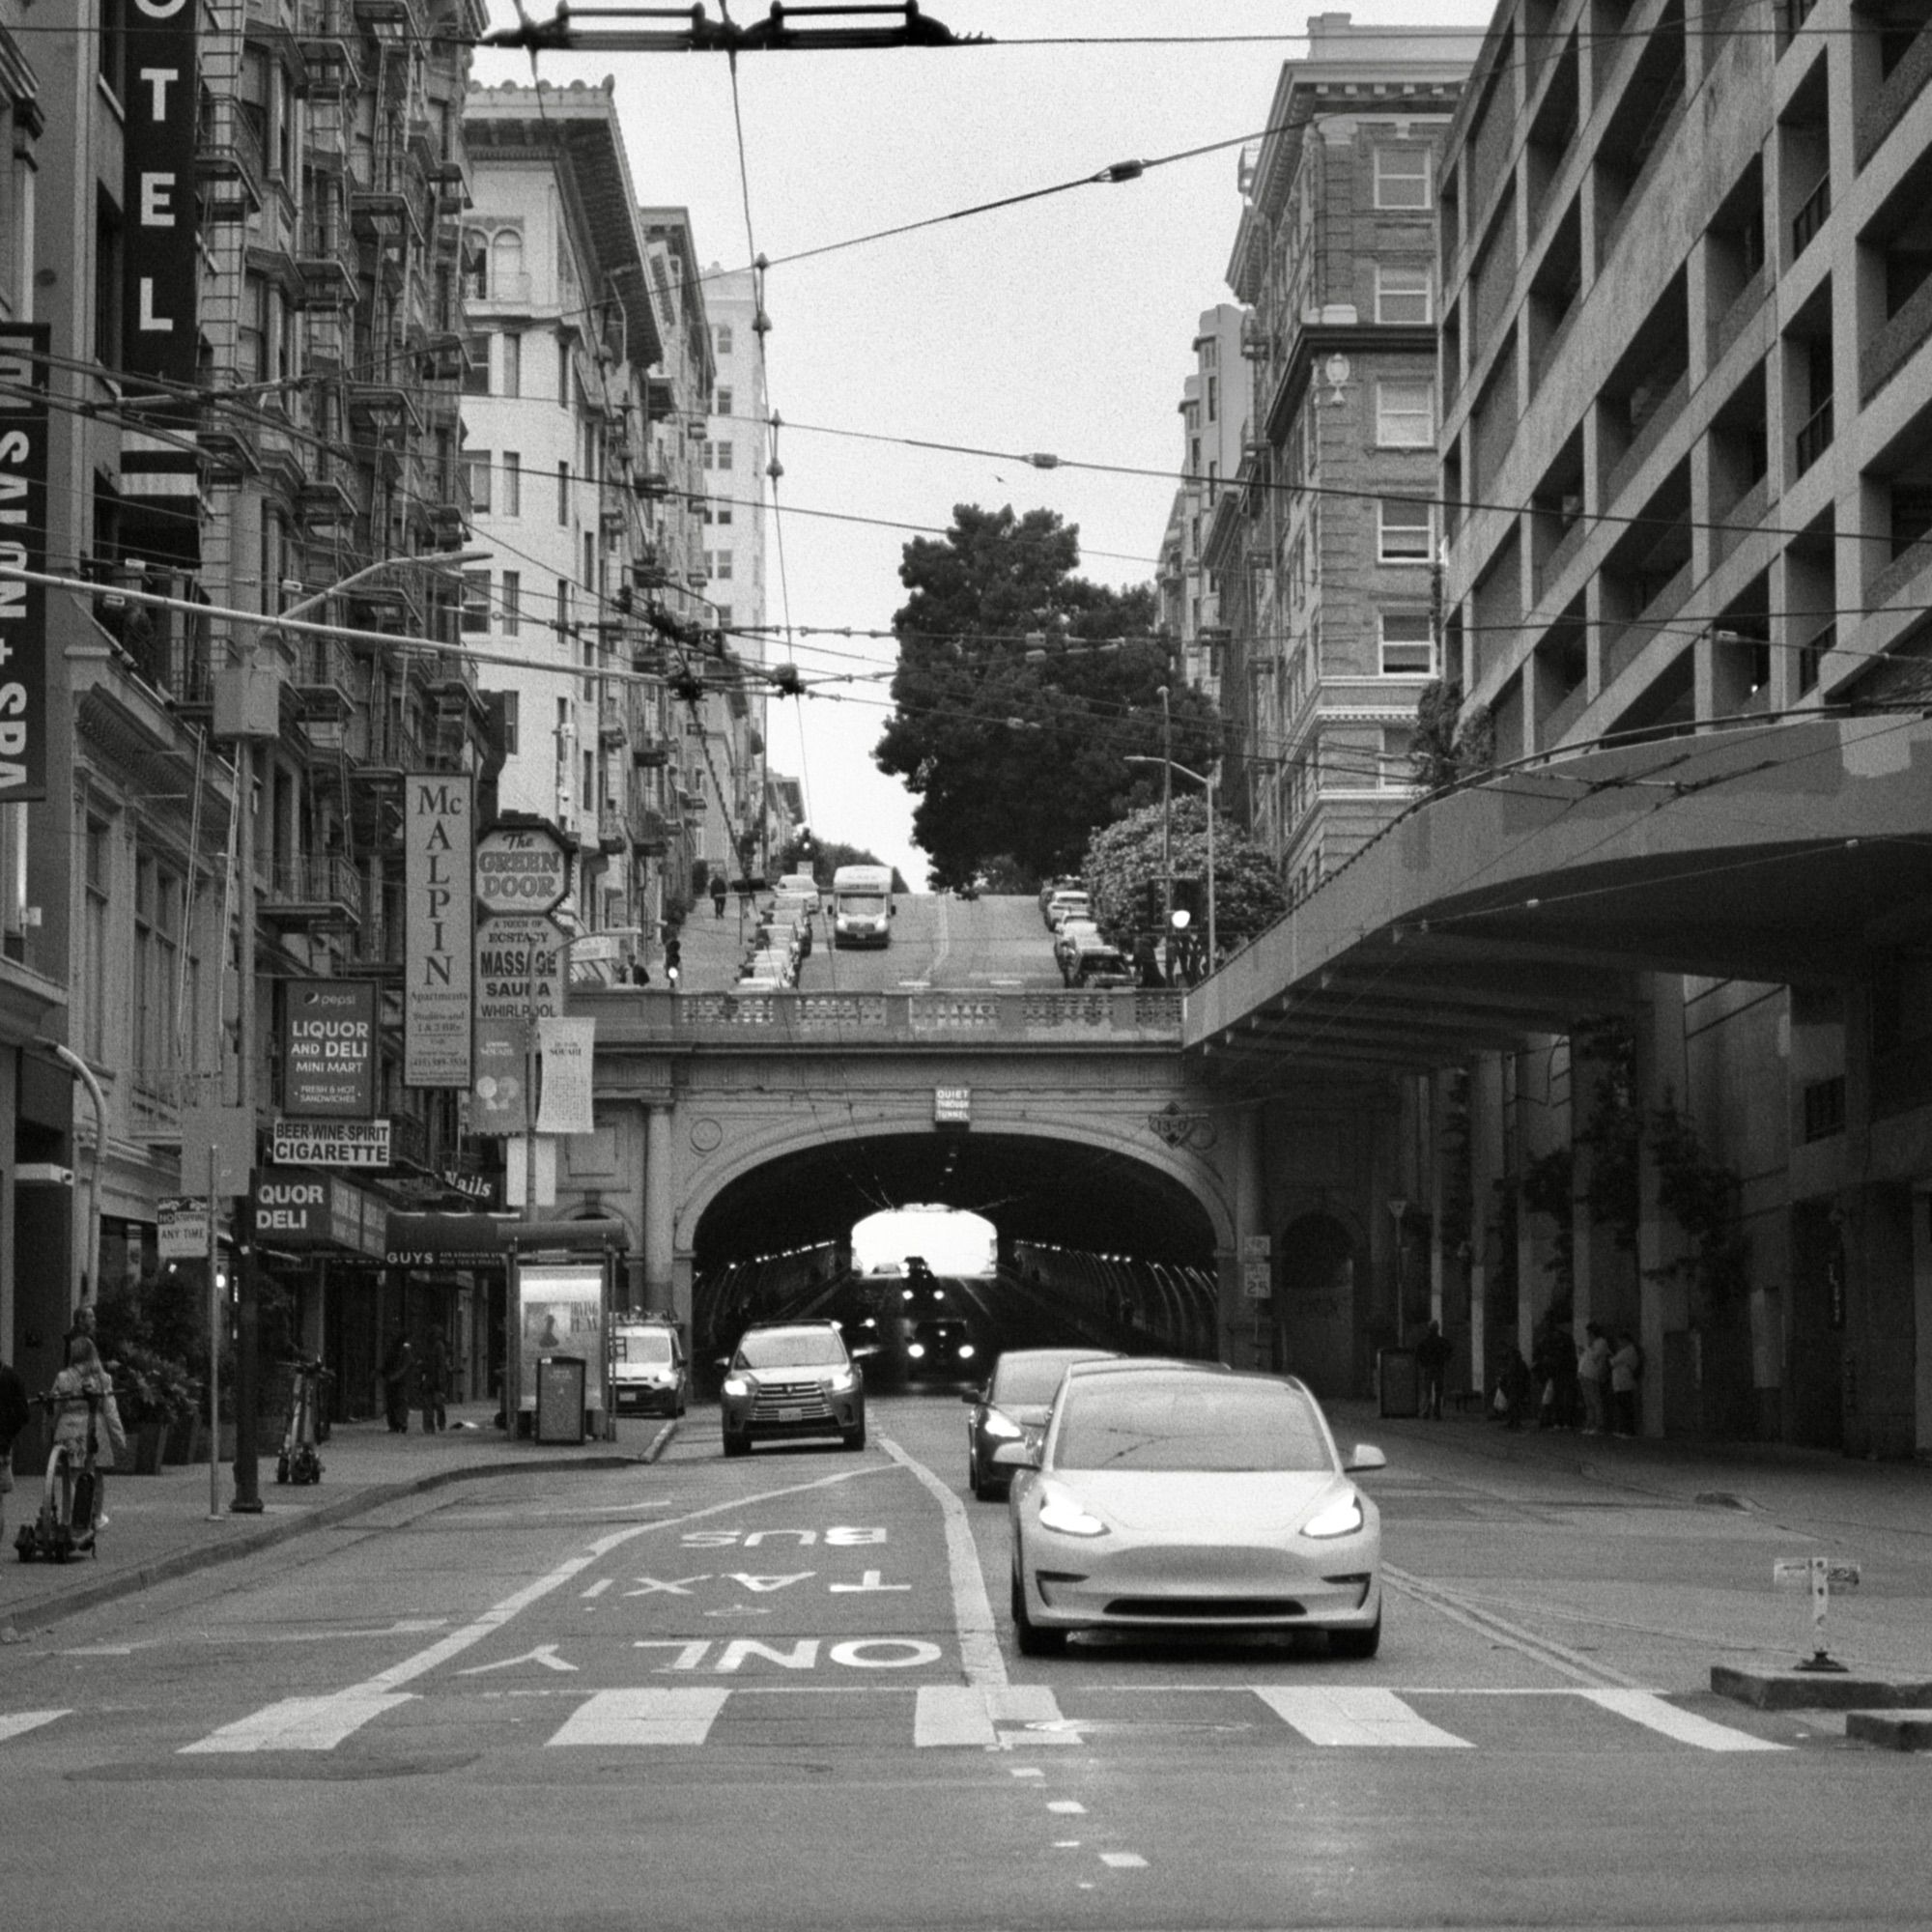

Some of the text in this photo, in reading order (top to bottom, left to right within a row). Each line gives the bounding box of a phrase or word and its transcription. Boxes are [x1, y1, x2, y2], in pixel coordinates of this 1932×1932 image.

[502, 833, 533, 850] The
[478, 851, 560, 873] GREEN
[483, 875, 556, 897] DOOR
[321, 994, 355, 1006] pepsi
[293, 1021, 369, 1038] LIQUOR
[291, 1041, 367, 1058] AND DELI
[296, 1062, 363, 1073] MINI MART
[300, 1085, 327, 1094] FRESH
[337, 1085, 355, 1094] HOT
[937, 1090, 969, 1098] QUIET
[299, 1094, 356, 1103] SANDWICHES
[275, 1142, 388, 1162] CIGARETTE
[445, 1171, 492, 1198] Nails
[158, 1213, 175, 1224] NO
[256, 1209, 307, 1229] DELI
[161, 1228, 204, 1239] ANY TIME
[387, 1252, 434, 1264] GUYS
[681, 1526, 887, 1548] BUS
[580, 1570, 912, 1599] TAXI
[451, 1639, 943, 1676] ONLY
